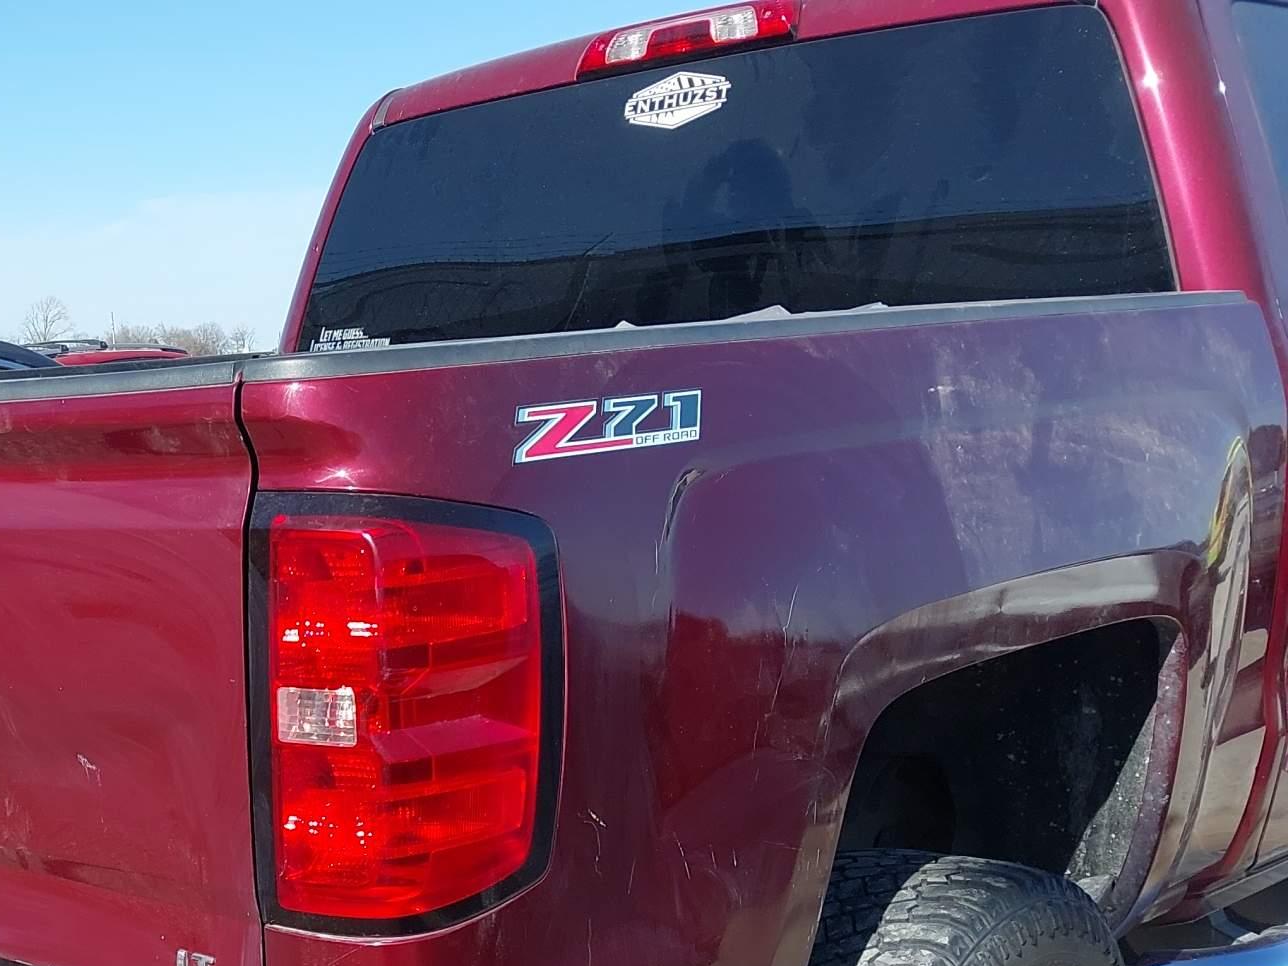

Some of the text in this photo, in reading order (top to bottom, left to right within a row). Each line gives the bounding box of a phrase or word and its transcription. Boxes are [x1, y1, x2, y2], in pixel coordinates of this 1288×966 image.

[624, 85, 730, 116] ENTHUZST
[320, 327, 332, 342] LET
[332, 329, 344, 341] ME
[310, 339, 336, 352] LICENSE
[343, 337, 390, 350] REGISTRATION
[513, 387, 703, 466] Z71
[635, 429, 698, 446] OFF ROAD
